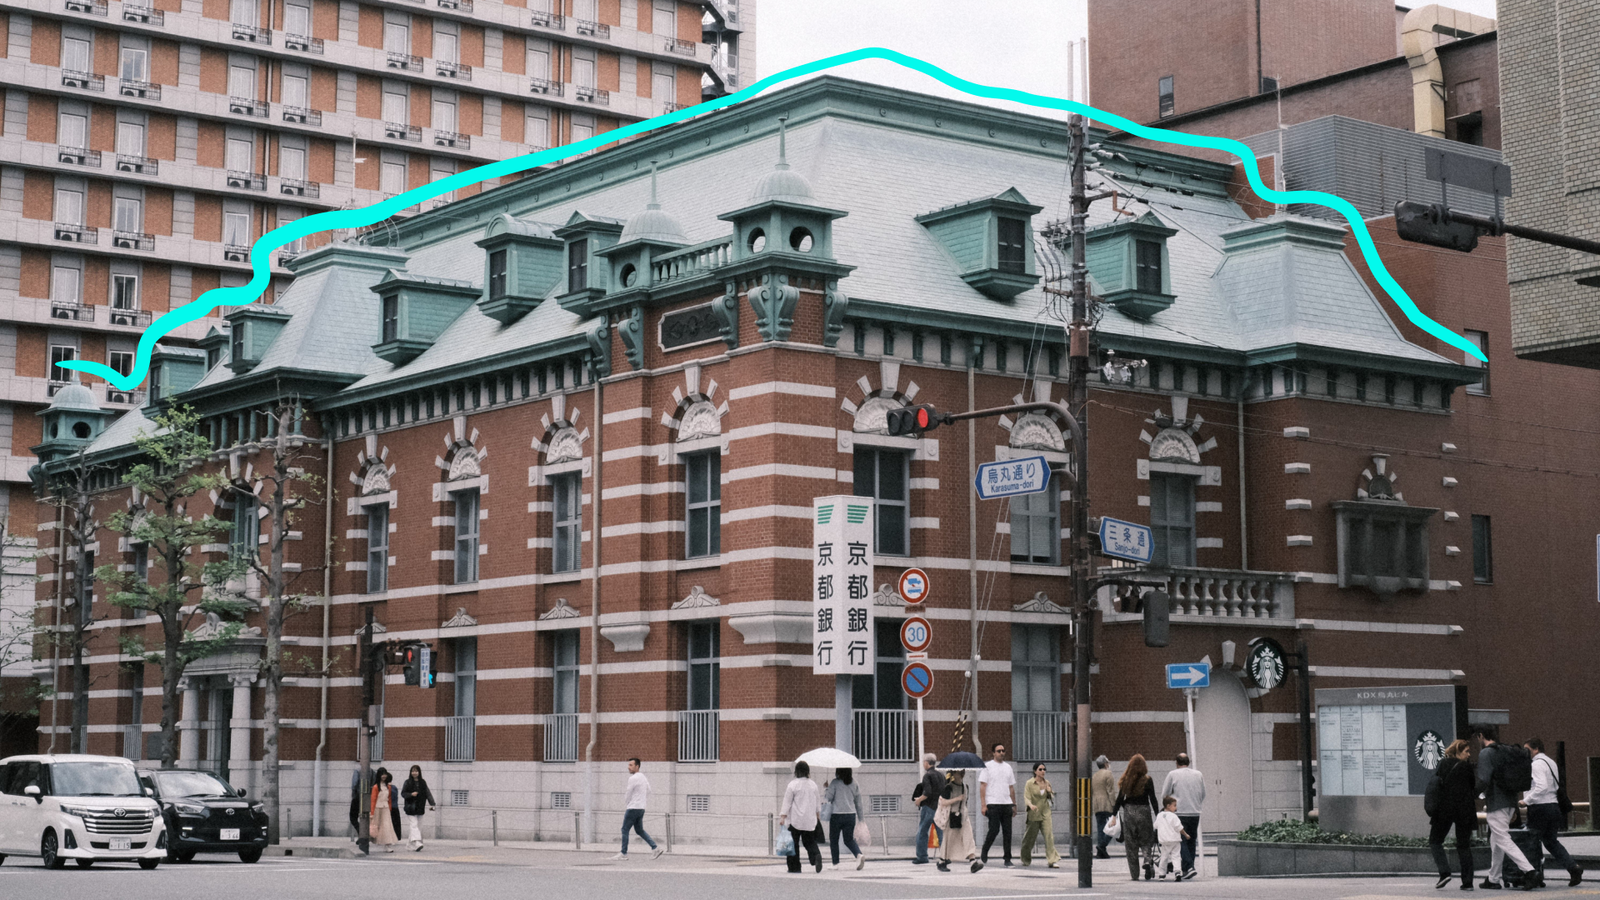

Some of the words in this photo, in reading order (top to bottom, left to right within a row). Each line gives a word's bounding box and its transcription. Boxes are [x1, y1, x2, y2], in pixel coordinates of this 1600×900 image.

[988, 462, 1036, 484] 烏丸通り
[991, 479, 1034, 493] Karasuma-dori
[1109, 524, 1145, 547] 三条通
[1115, 541, 1140, 555] Sanjo-dori
[817, 541, 834, 666] 京都銀行
[847, 541, 869, 666] 京都銀行
[907, 626, 925, 642] 30
